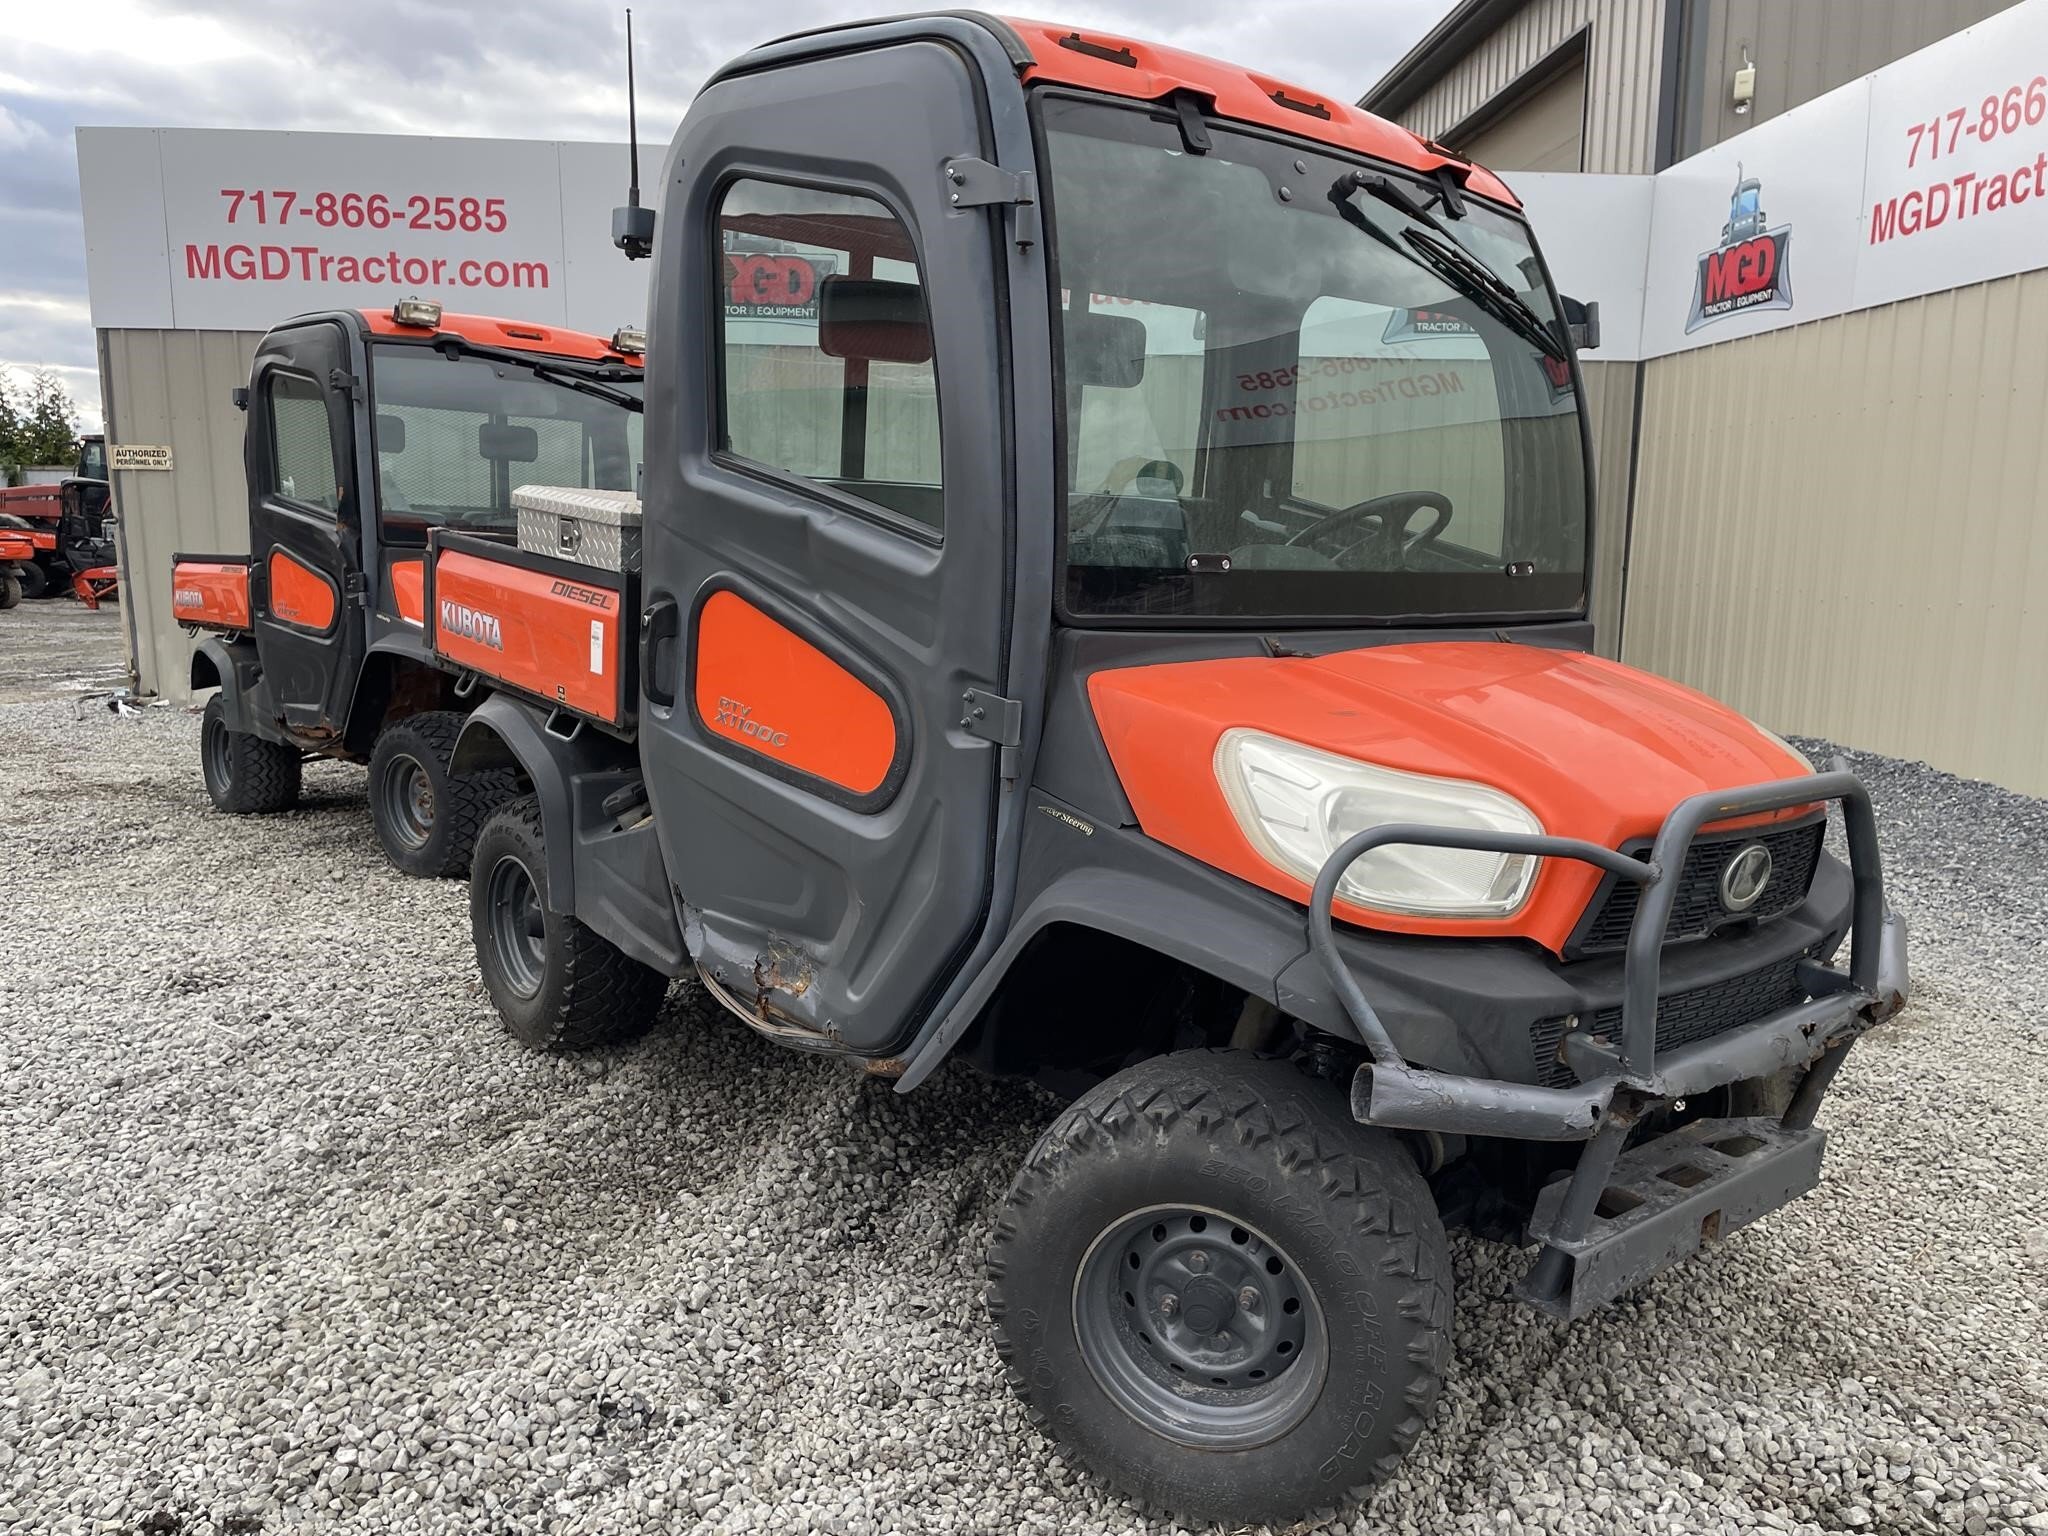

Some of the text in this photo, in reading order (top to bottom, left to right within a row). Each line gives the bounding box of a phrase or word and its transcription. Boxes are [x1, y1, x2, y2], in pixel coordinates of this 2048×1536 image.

[220, 189, 508, 233] 717-866-2585
[185, 244, 550, 289] MGDTractor.com
[1705, 235, 1775, 304] MGD
[757, 306, 816, 318] EQUIPMENT
[1705, 299, 1732, 316] TRACTOR
[1736, 288, 1773, 308] EQUIPMENT
[1416, 321, 1461, 332] TRACTOR
[116, 449, 167, 458] AUTHORIZED
[116, 458, 151, 466] PERSONNEL
[175, 590, 203, 608] KUBOTA
[550, 581, 613, 610] DIESEL
[441, 599, 504, 651] KUBOTA
[1060, 813, 1094, 837] Steering
